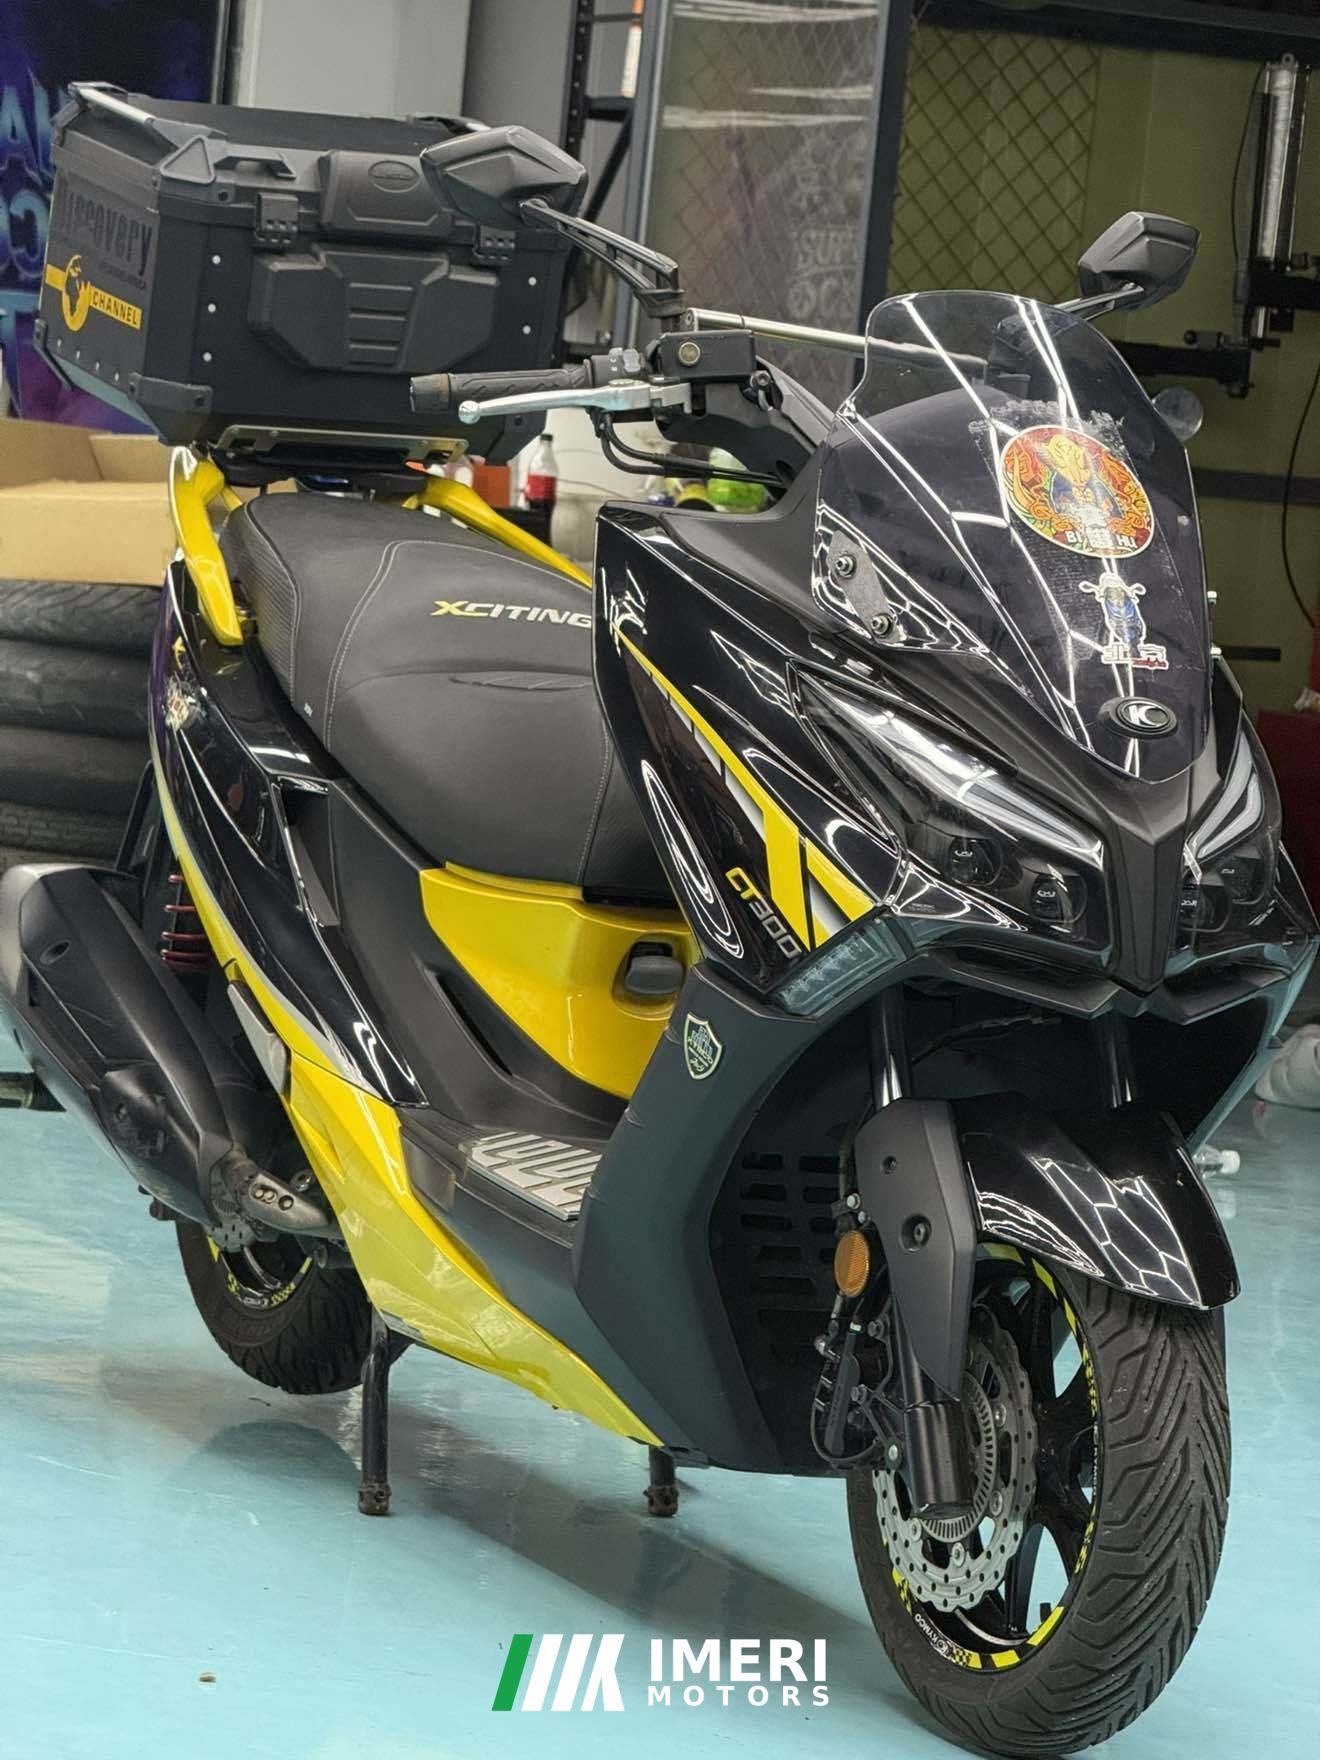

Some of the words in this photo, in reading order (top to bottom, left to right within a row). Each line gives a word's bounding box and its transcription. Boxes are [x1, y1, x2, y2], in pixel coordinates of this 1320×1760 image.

[92, 291, 139, 325] CHANNEL
[431, 600, 593, 629] XCITING
[914, 1613, 938, 1643] KYMCO
